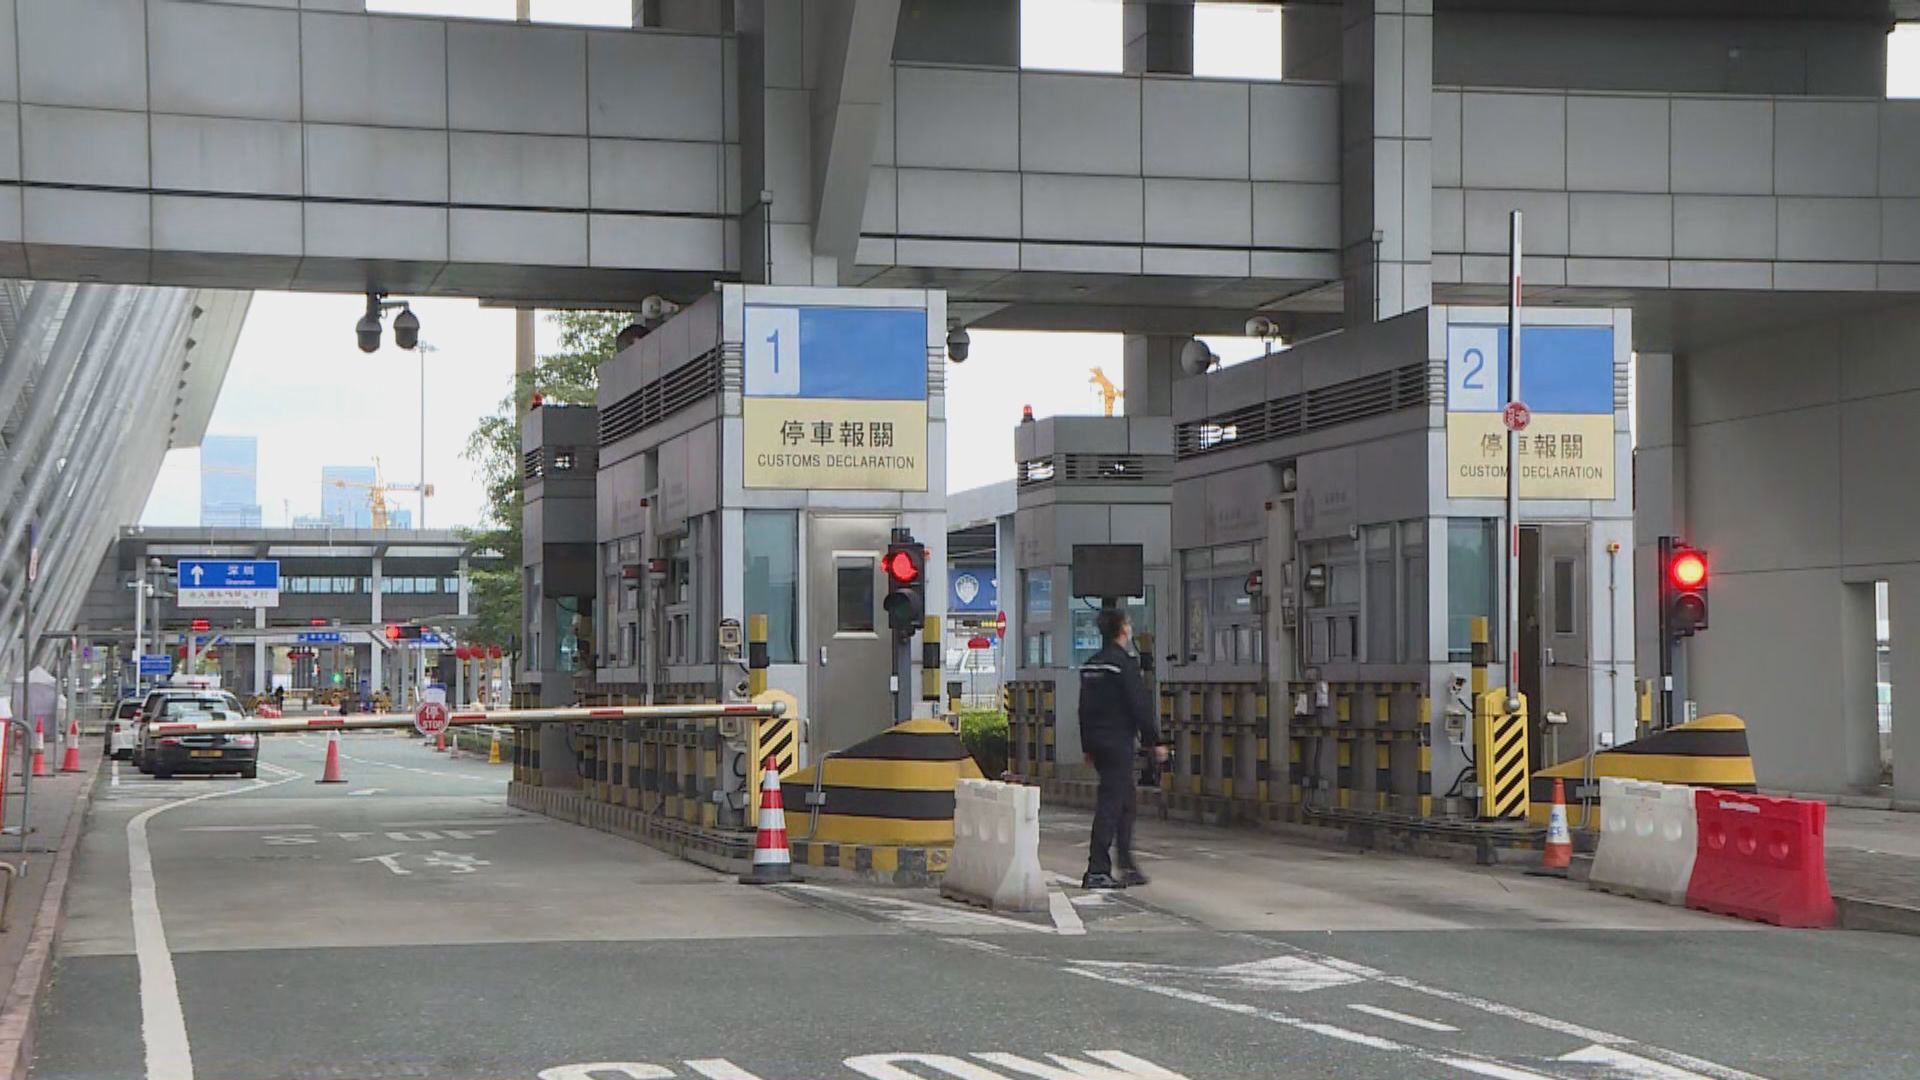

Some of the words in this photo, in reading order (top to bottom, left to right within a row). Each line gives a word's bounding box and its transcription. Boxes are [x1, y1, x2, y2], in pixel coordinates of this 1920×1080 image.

[766, 329, 780, 374] 1
[1463, 348, 1485, 389] 2
[780, 420, 893, 448] 停車報關
[757, 453, 821, 468] CUSTOMS
[826, 454, 915, 469] DECLARATION
[1460, 464, 1508, 479] CUSTOM
[1522, 465, 1603, 479] DECLARATION
[422, 720, 444, 730] STOP
